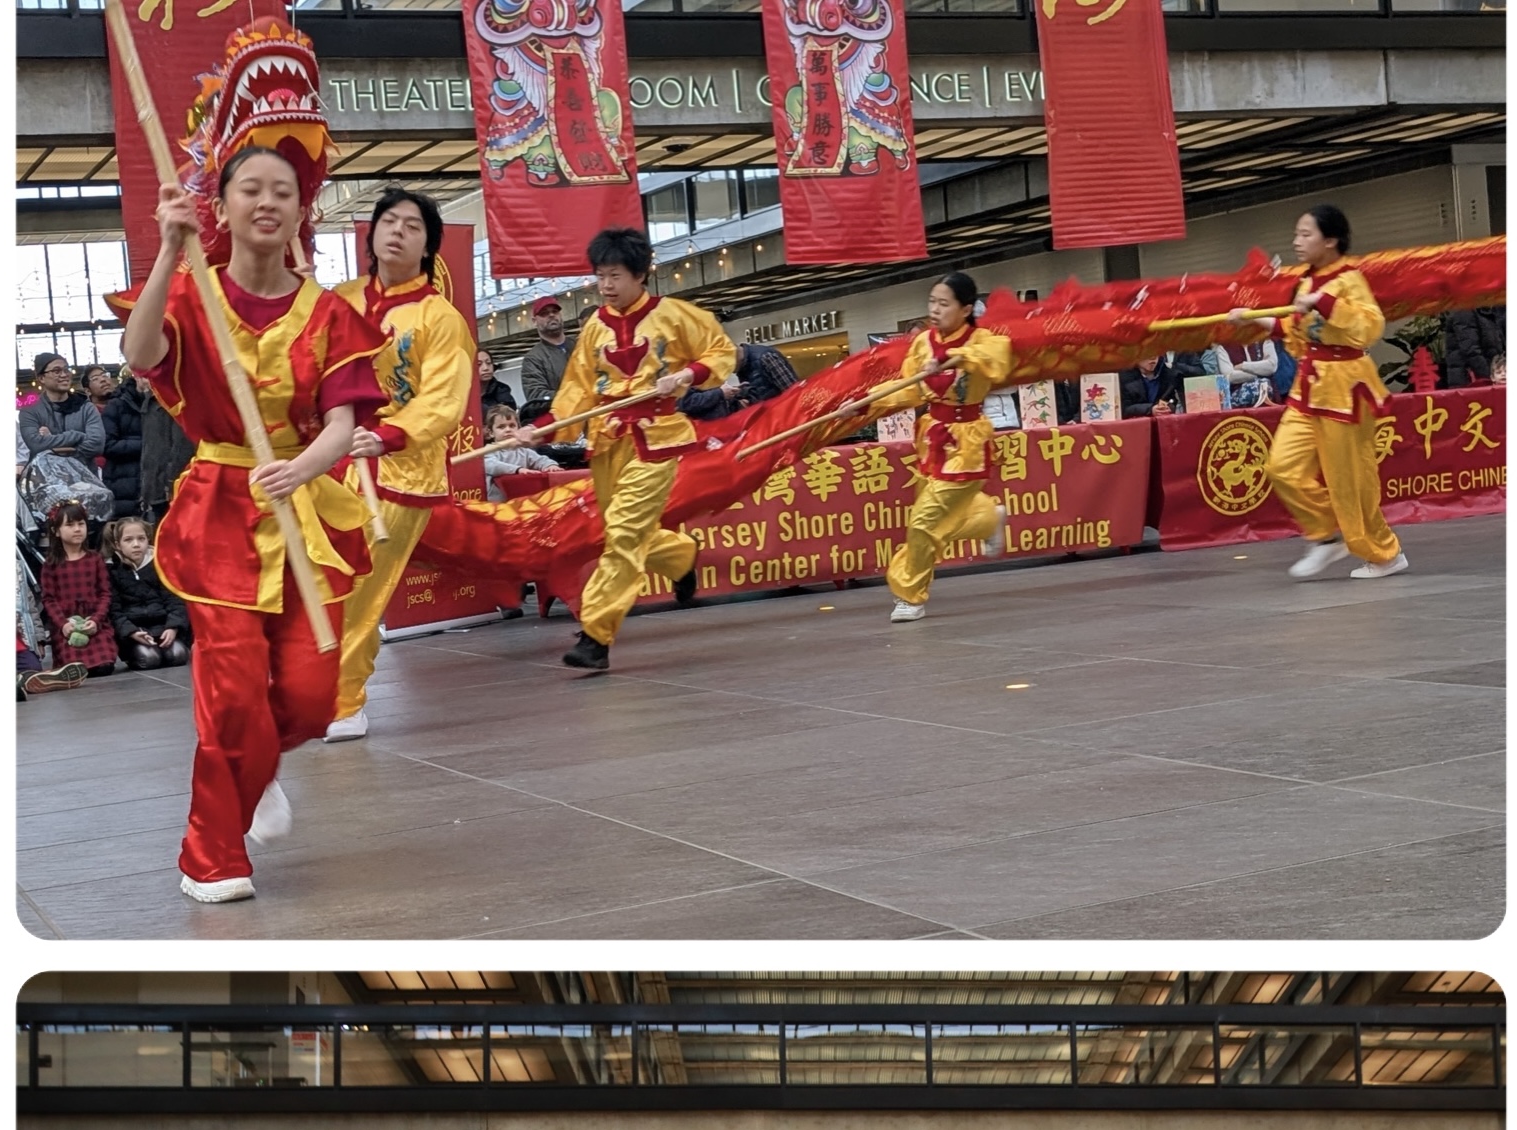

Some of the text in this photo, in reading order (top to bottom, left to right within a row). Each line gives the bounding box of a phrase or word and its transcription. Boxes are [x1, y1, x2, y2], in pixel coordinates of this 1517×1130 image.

[329, 76, 474, 111] THEATE
[1005, 71, 1045, 101] EV
[808, 50, 835, 167] 萬事勝意
[744, 311, 838, 345] BELL MARKET
[1386, 472, 1453, 499] SHORE
[680, 521, 767, 551] ersey
[778, 506, 855, 542] Shore
[730, 551, 820, 587] Center
[830, 544, 867, 574] for
[1004, 517, 1112, 553] Learning
